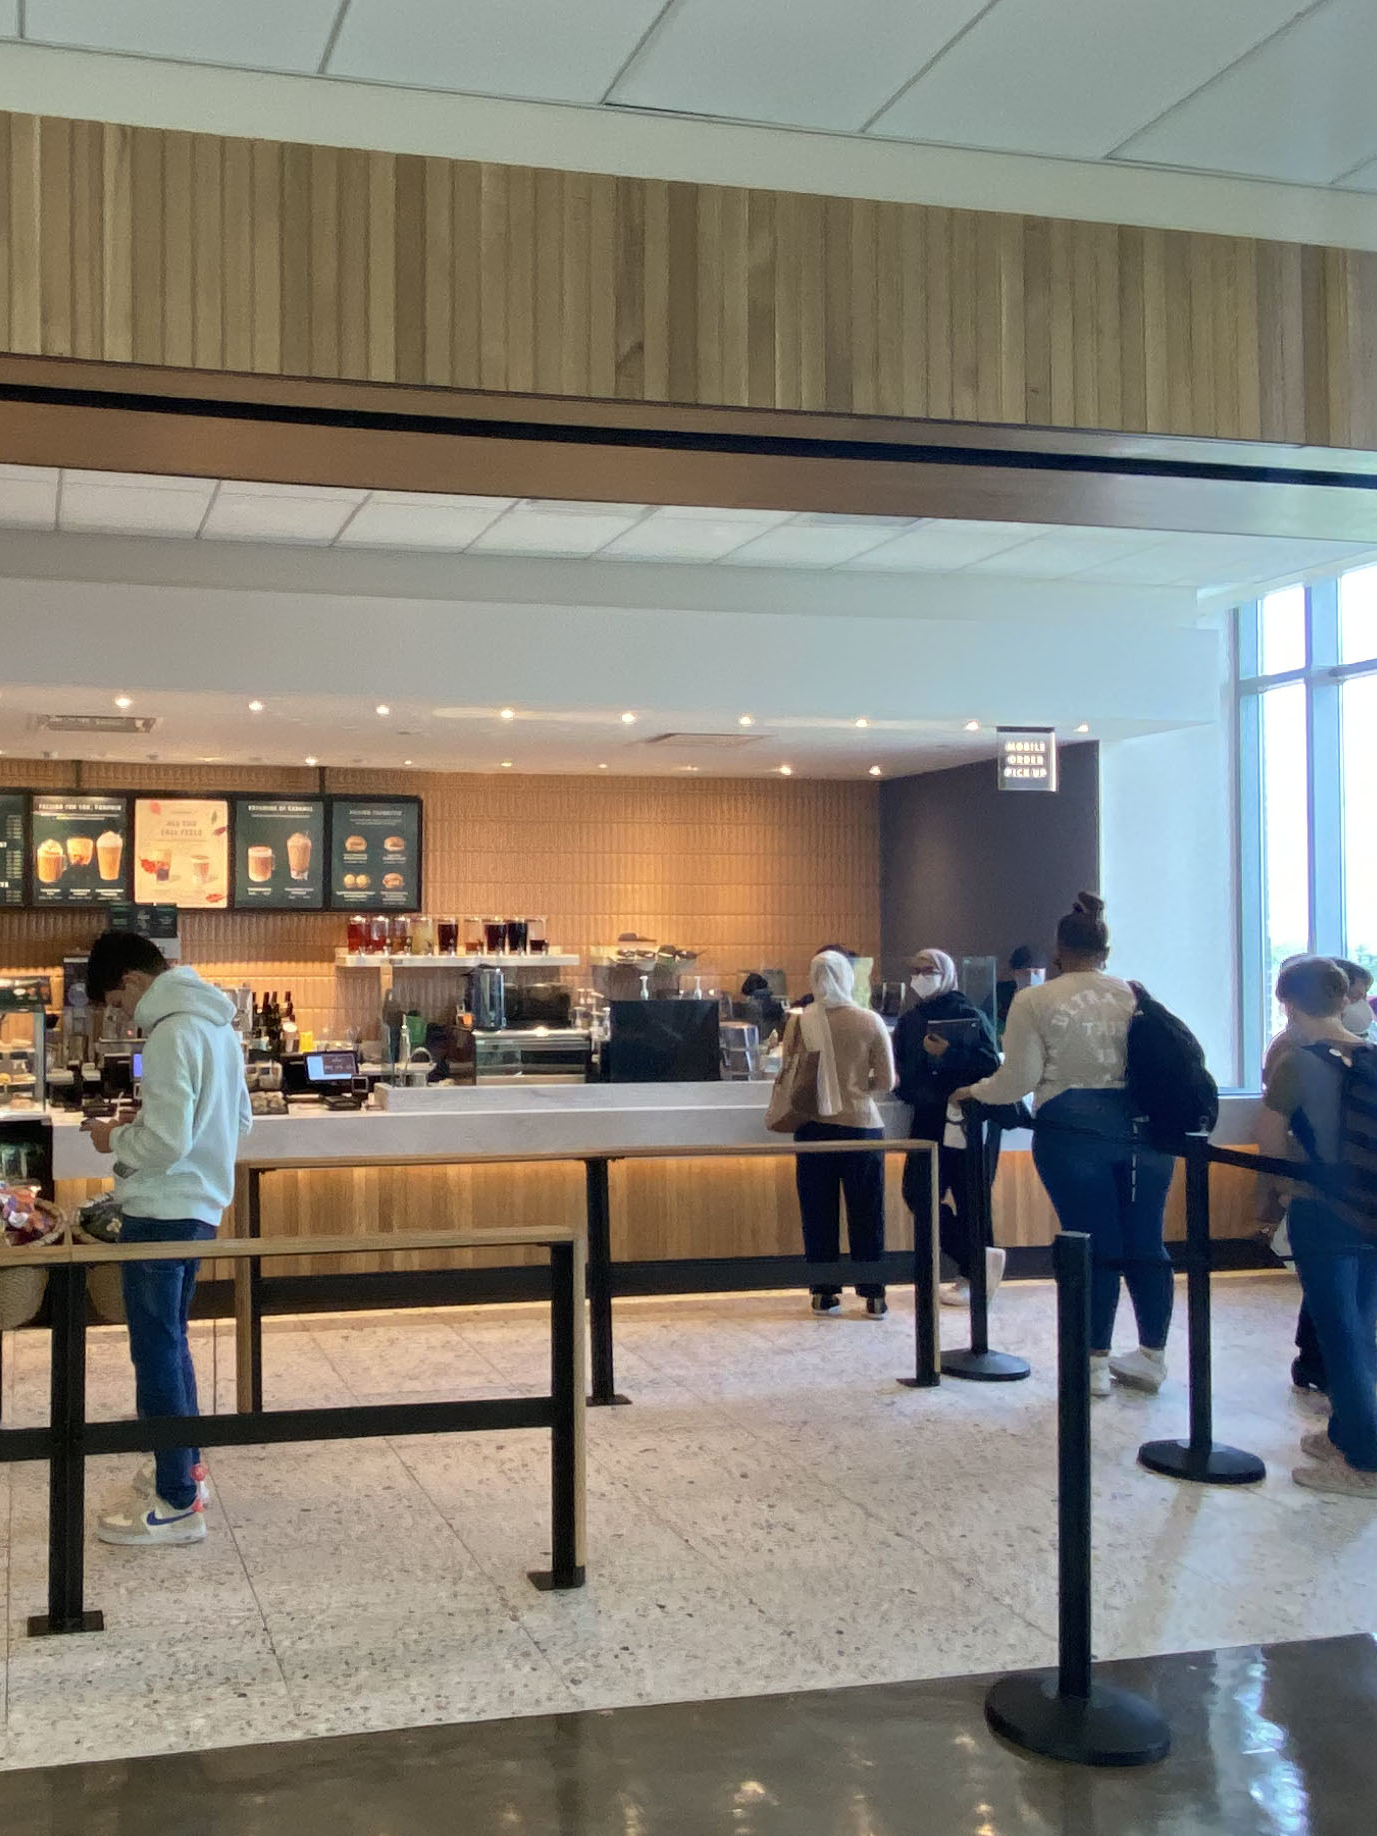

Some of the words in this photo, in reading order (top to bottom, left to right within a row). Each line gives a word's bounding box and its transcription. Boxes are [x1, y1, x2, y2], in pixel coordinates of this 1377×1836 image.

[1005, 742, 1045, 752] MOBILE
[1007, 755, 1044, 766] ORDER
[1004, 767, 1030, 777] PICK
[1032, 767, 1047, 778] UP
